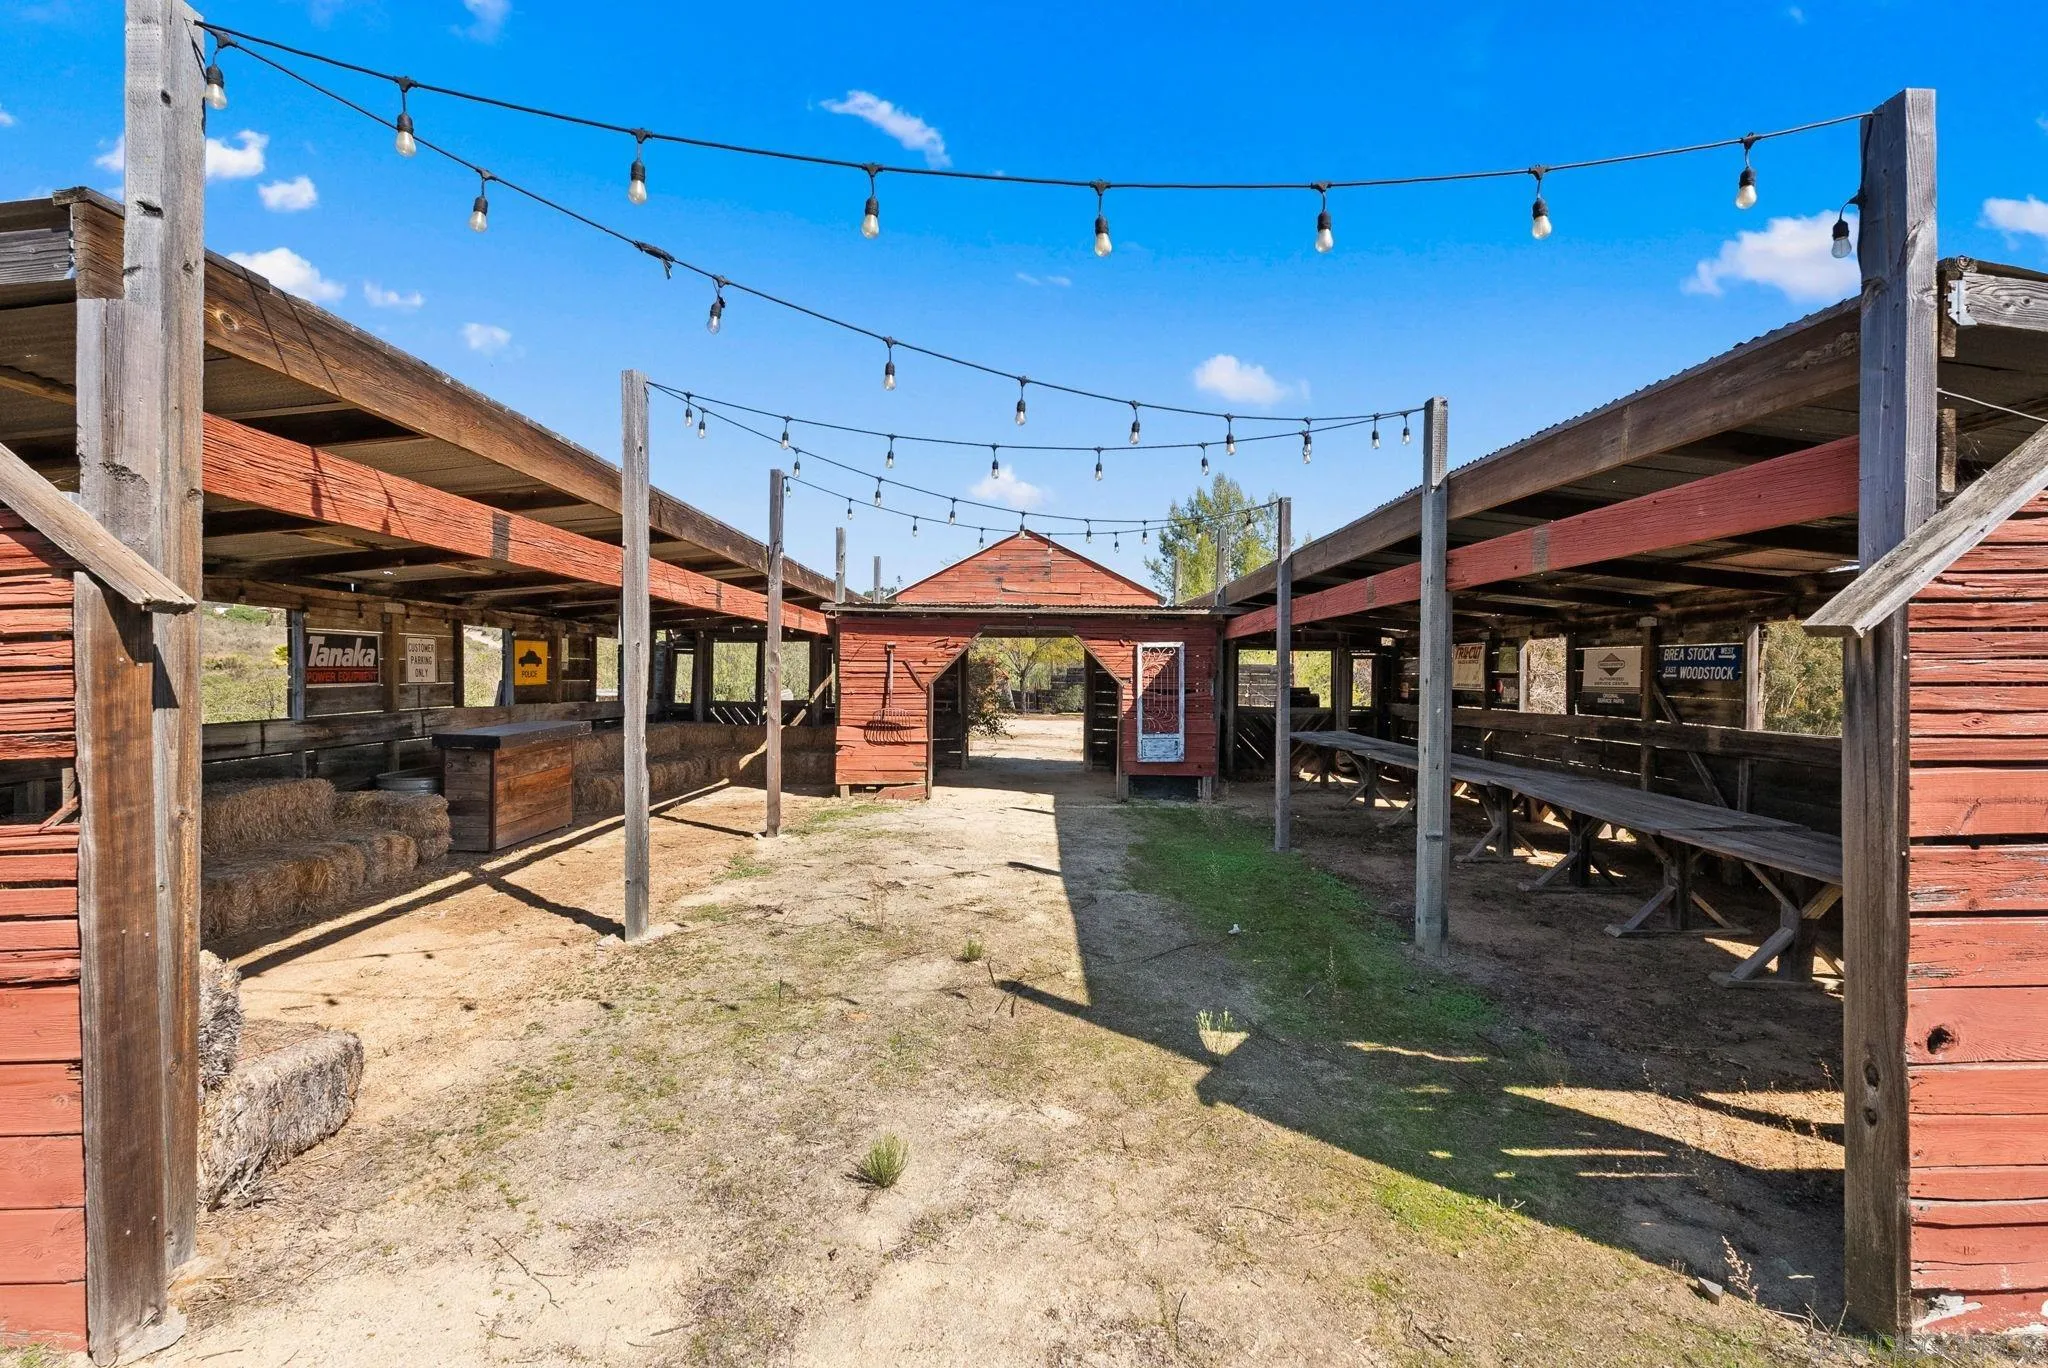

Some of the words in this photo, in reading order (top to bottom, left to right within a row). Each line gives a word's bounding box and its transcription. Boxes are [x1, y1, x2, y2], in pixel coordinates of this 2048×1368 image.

[308, 636, 376, 667] Tanaka
[408, 643, 434, 652] CUSTOMER
[1664, 648, 1684, 661] BREA
[1687, 647, 1716, 661] STOCK
[410, 655, 432, 665] PARKING
[306, 671, 336, 682] POWER
[338, 671, 379, 681] EQUIPMENT
[414, 668, 429, 678] ONLY
[521, 670, 538, 678] POLICE
[1680, 666, 1735, 680] WOODSTOCK
